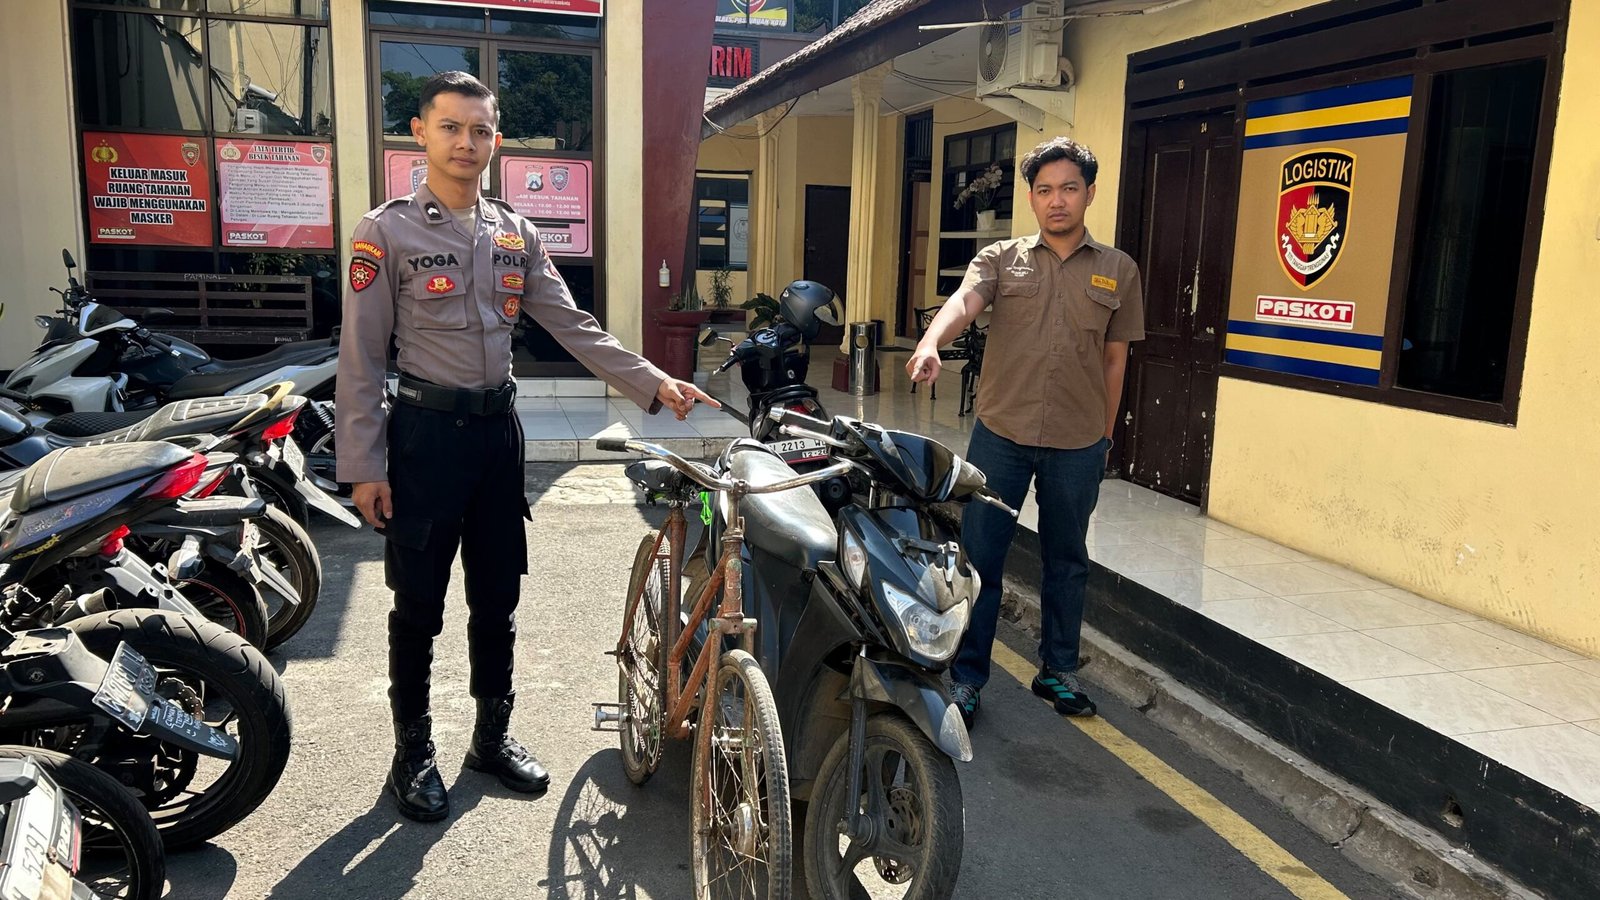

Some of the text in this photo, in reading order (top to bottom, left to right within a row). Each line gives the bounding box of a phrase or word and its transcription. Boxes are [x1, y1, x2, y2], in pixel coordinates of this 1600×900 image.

[110, 167, 188, 182] KELUAR MASUK
[1285, 158, 1352, 185] LOGISTIK
[107, 182, 191, 196] RUANG TAHANAN
[94, 196, 206, 212] WAJIB MENGGUNAKAN
[130, 212, 174, 225] MASKER
[540, 233, 569, 242] SKOT
[408, 253, 459, 272] YOGA
[1259, 300, 1351, 320] PASKOT
[782, 441, 805, 451] 2213
[22, 822, 48, 880] 5291
